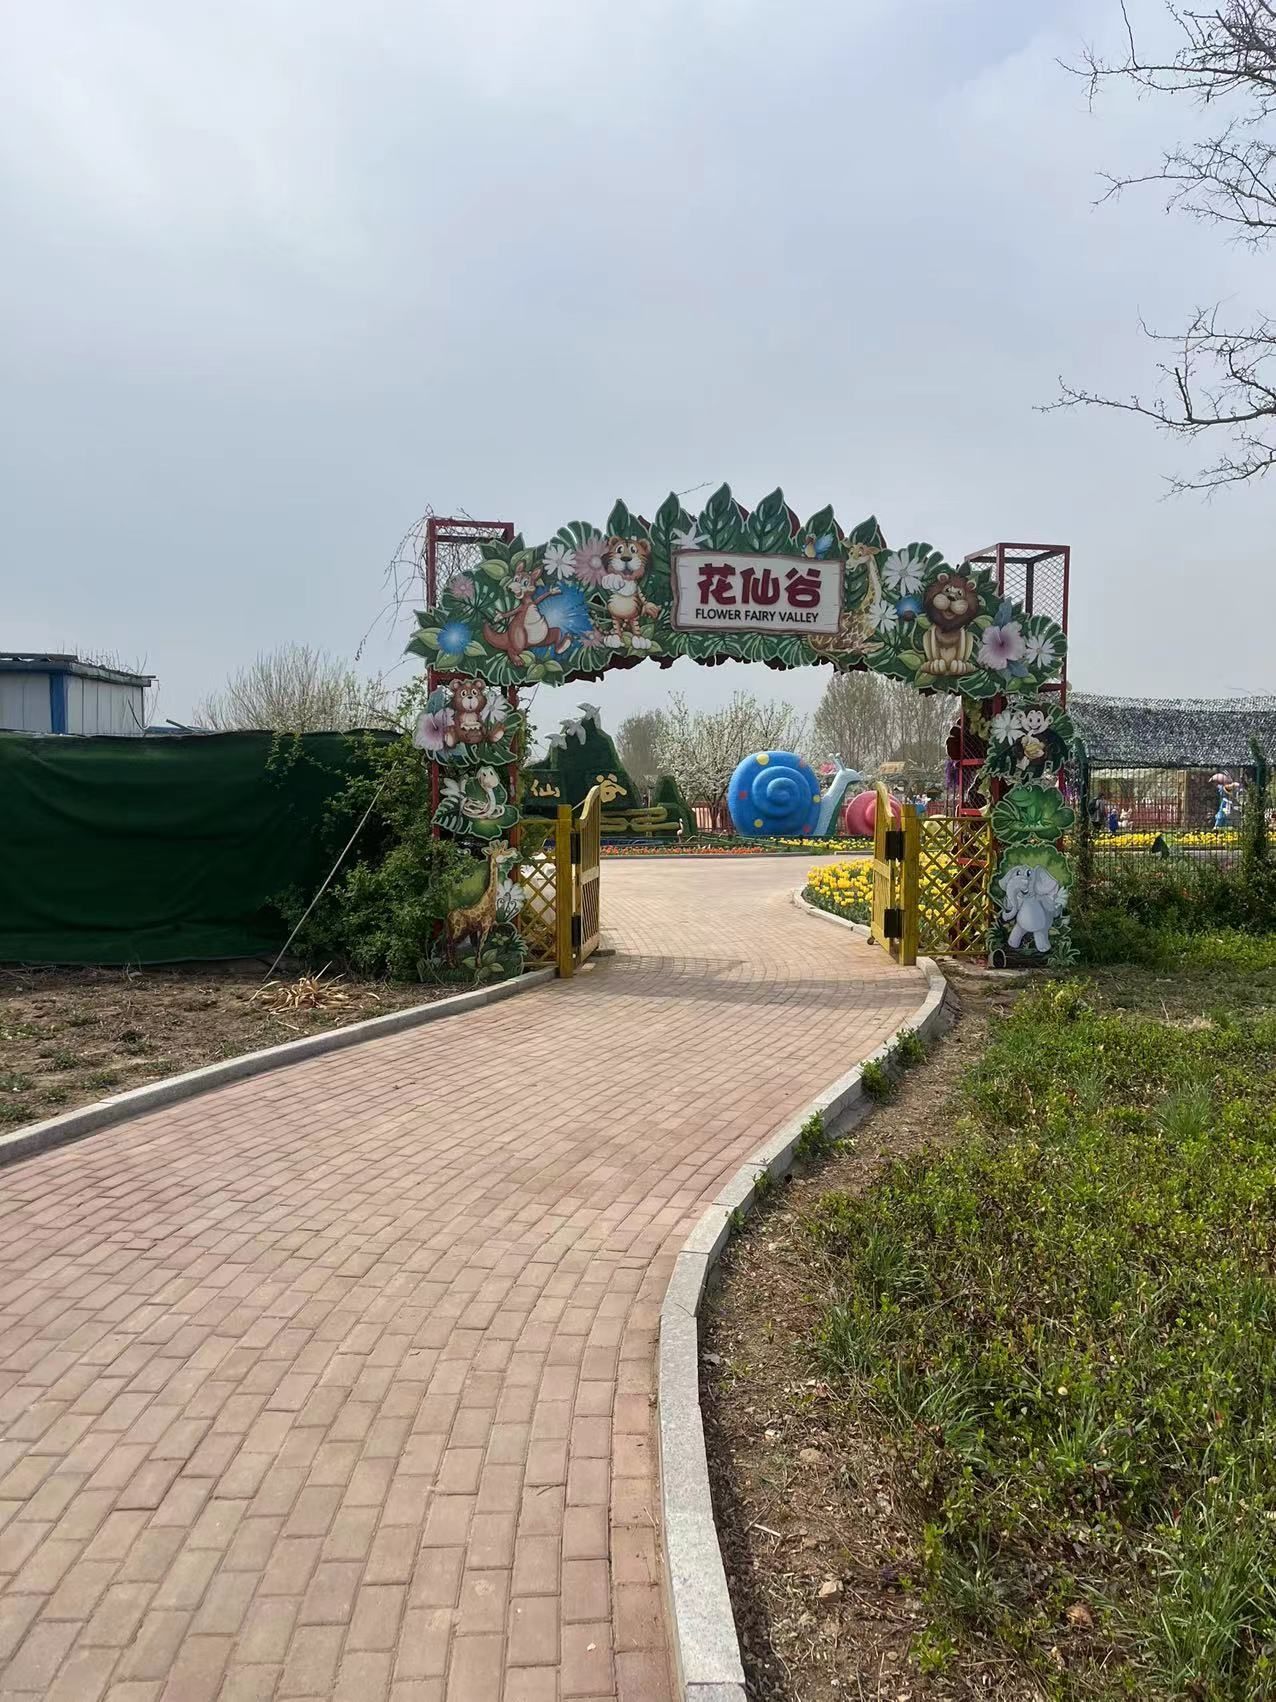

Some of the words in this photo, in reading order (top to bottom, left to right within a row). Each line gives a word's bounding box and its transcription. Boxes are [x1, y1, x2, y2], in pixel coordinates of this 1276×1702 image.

[697, 563, 822, 608] 花仙谷
[695, 608, 742, 621] FLOWER
[744, 610, 775, 622] FAIRY
[779, 611, 819, 623] VALLEY
